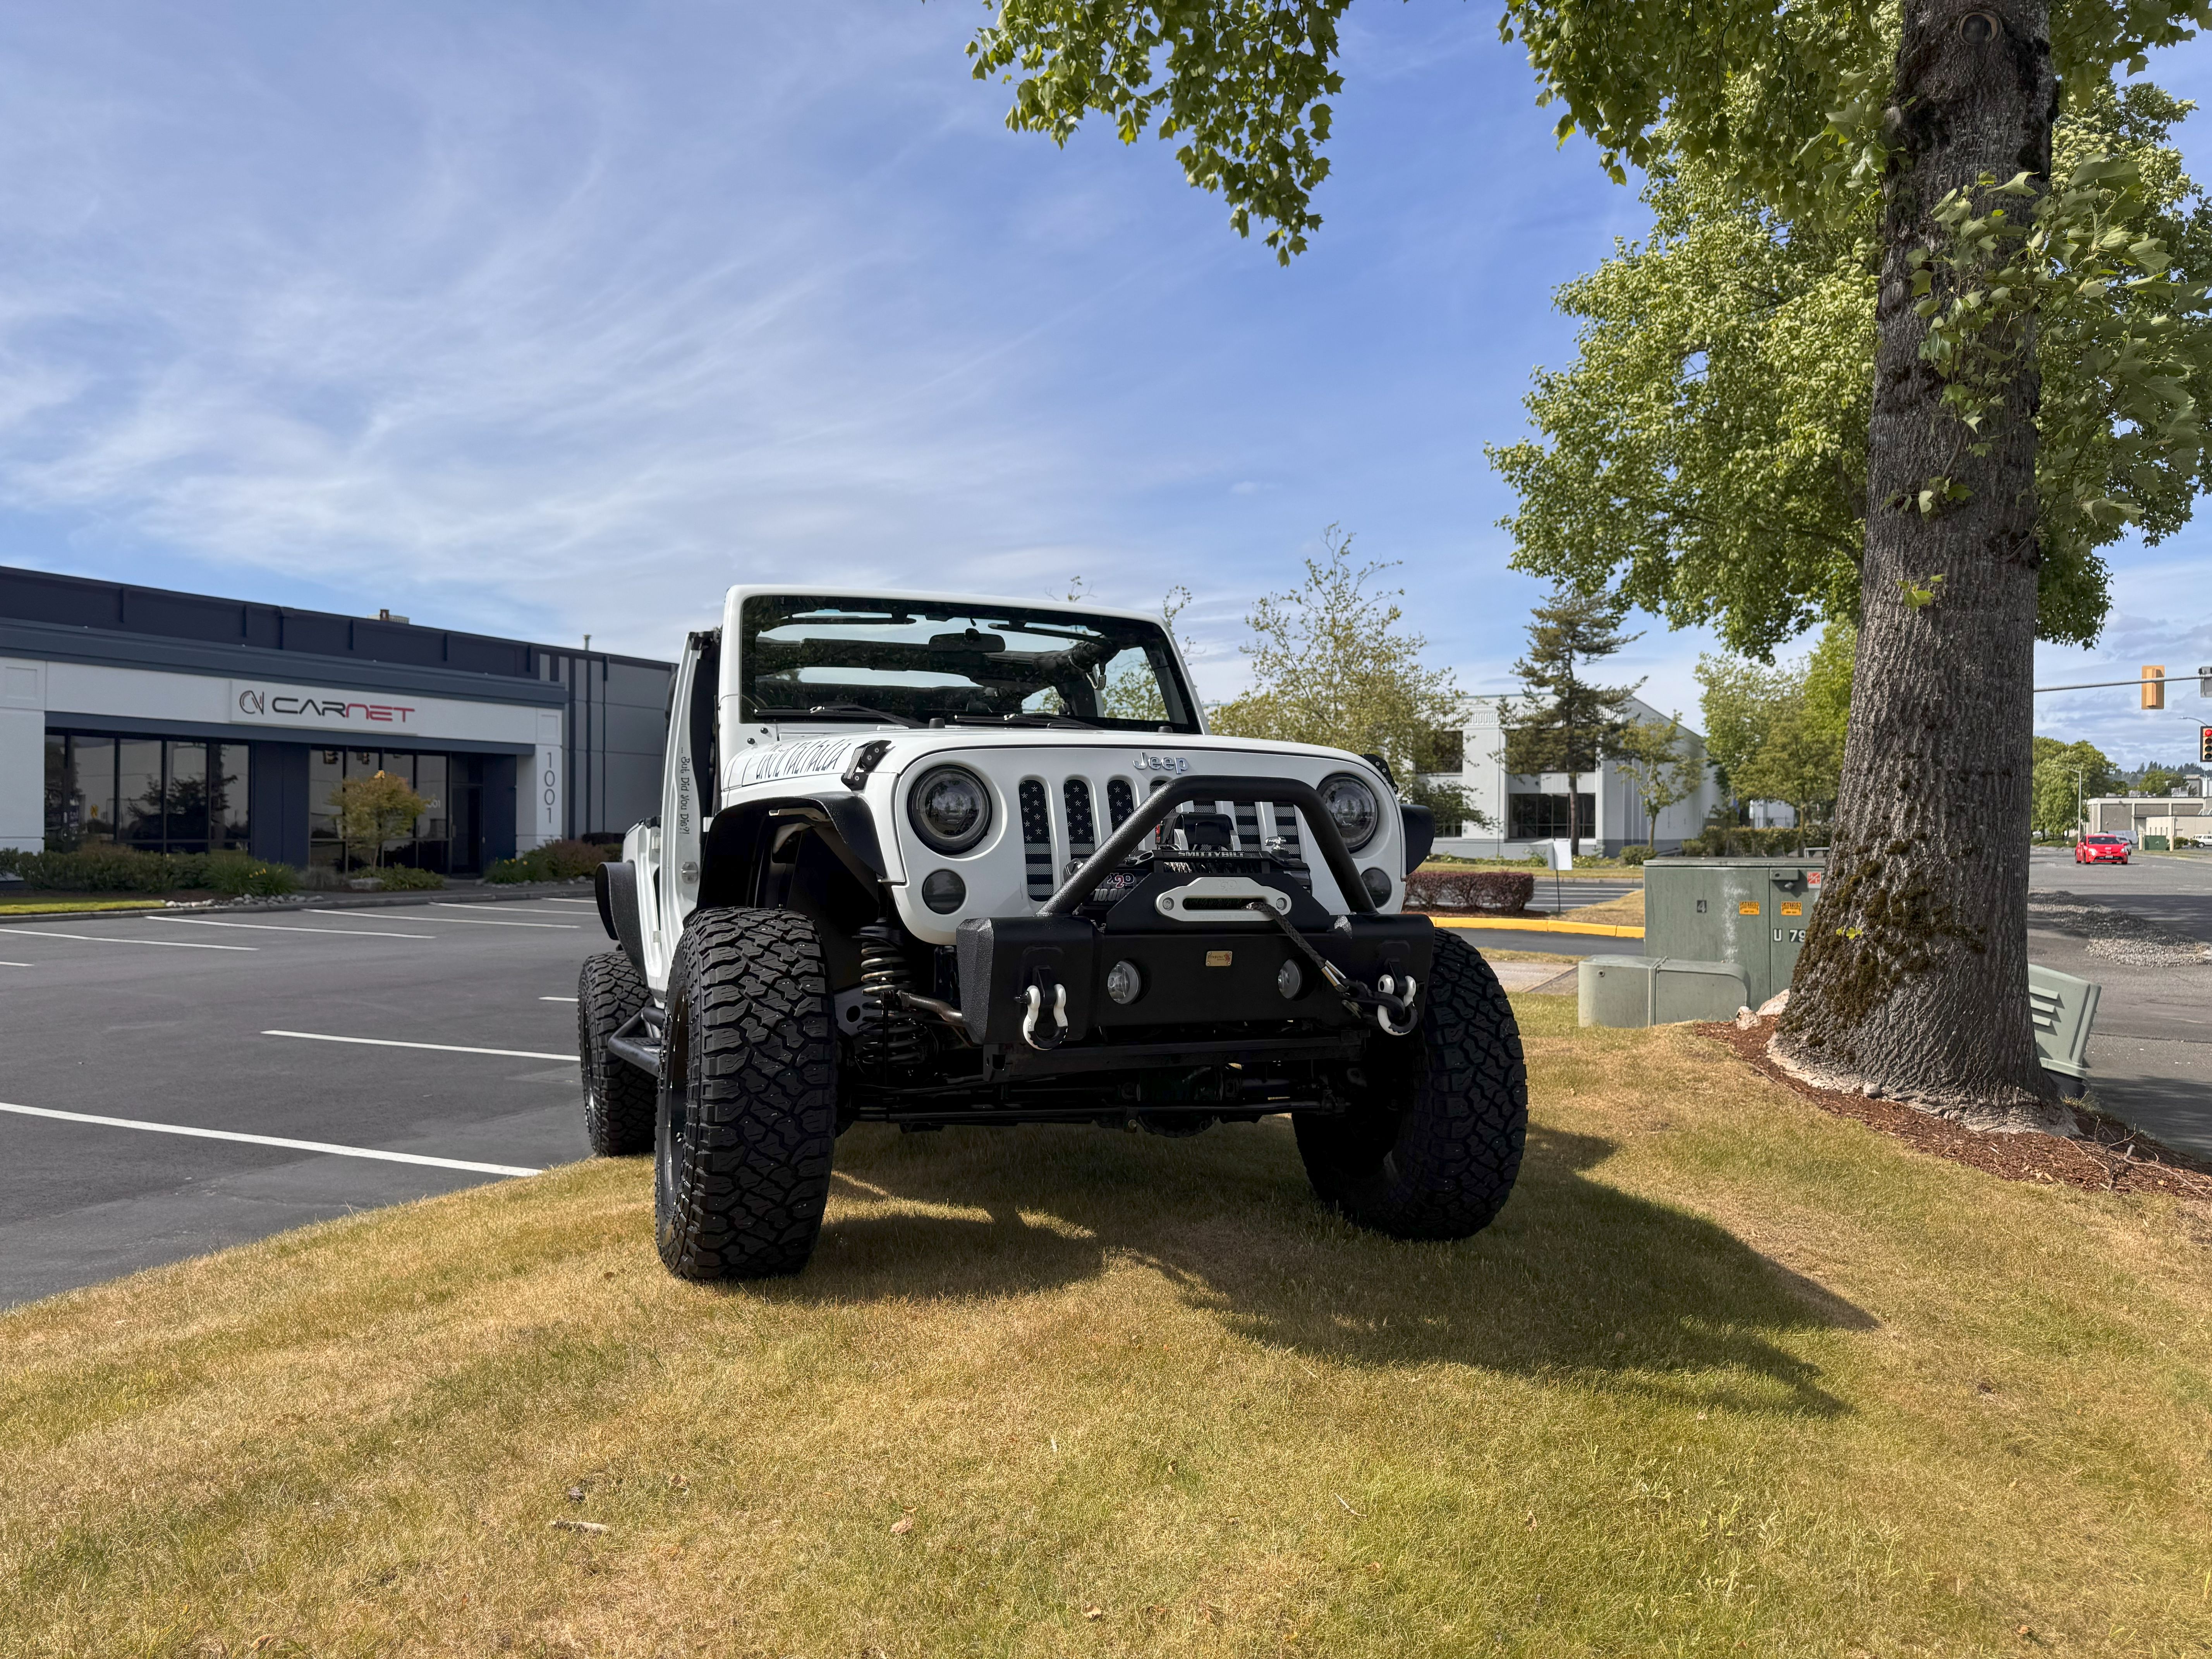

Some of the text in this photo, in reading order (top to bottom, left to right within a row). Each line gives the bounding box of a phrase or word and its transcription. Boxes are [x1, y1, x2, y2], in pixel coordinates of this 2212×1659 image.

[272, 697, 415, 723] CARNET
[680, 757, 690, 773] But
[1133, 752, 1189, 775] Jeep
[544, 752, 555, 823] 1001
[680, 777, 690, 791] Did
[1093, 888, 1133, 902] 10,00
[1697, 902, 1706, 913] 4
[1773, 929, 1782, 941] U
